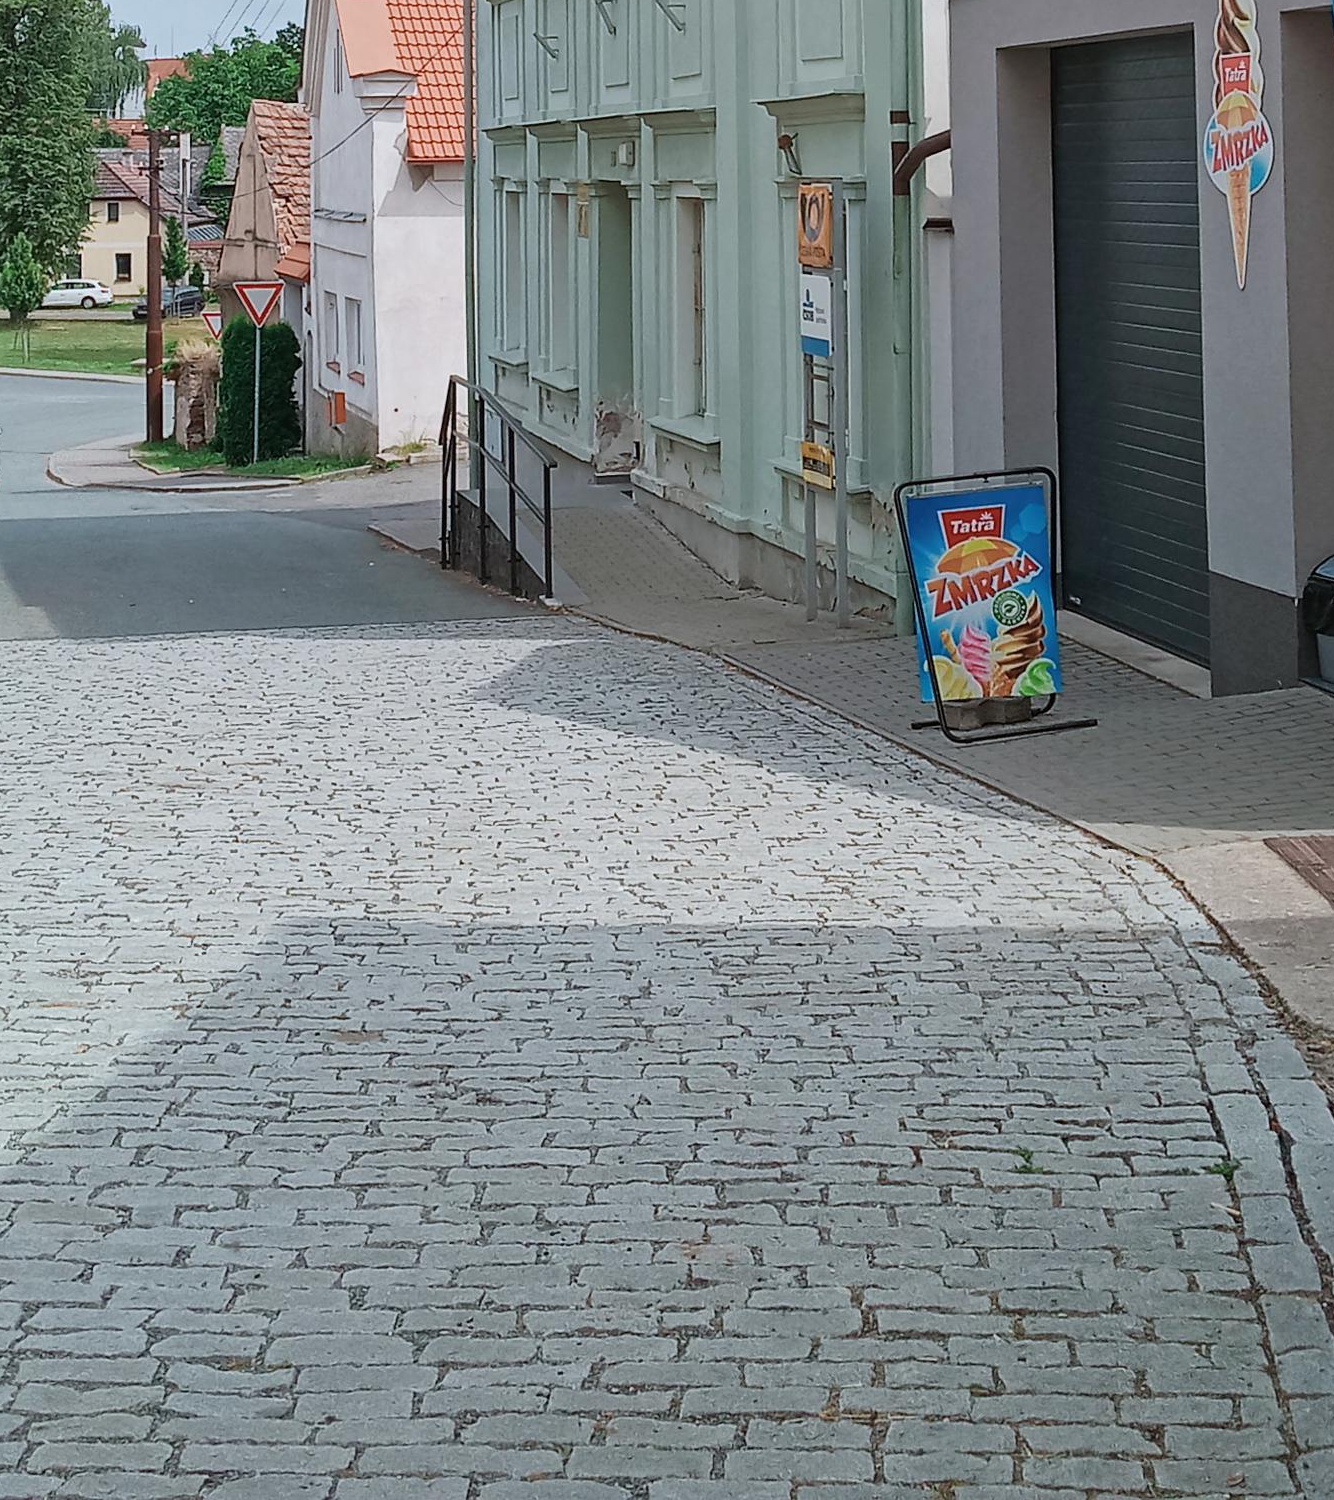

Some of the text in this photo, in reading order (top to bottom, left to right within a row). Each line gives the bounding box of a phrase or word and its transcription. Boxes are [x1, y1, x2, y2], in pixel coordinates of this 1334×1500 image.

[1224, 67, 1247, 82] Tatra
[1210, 120, 1269, 173] ZMRZKA
[951, 519, 995, 534] Tatra
[926, 554, 1040, 618] ZMRZKA
